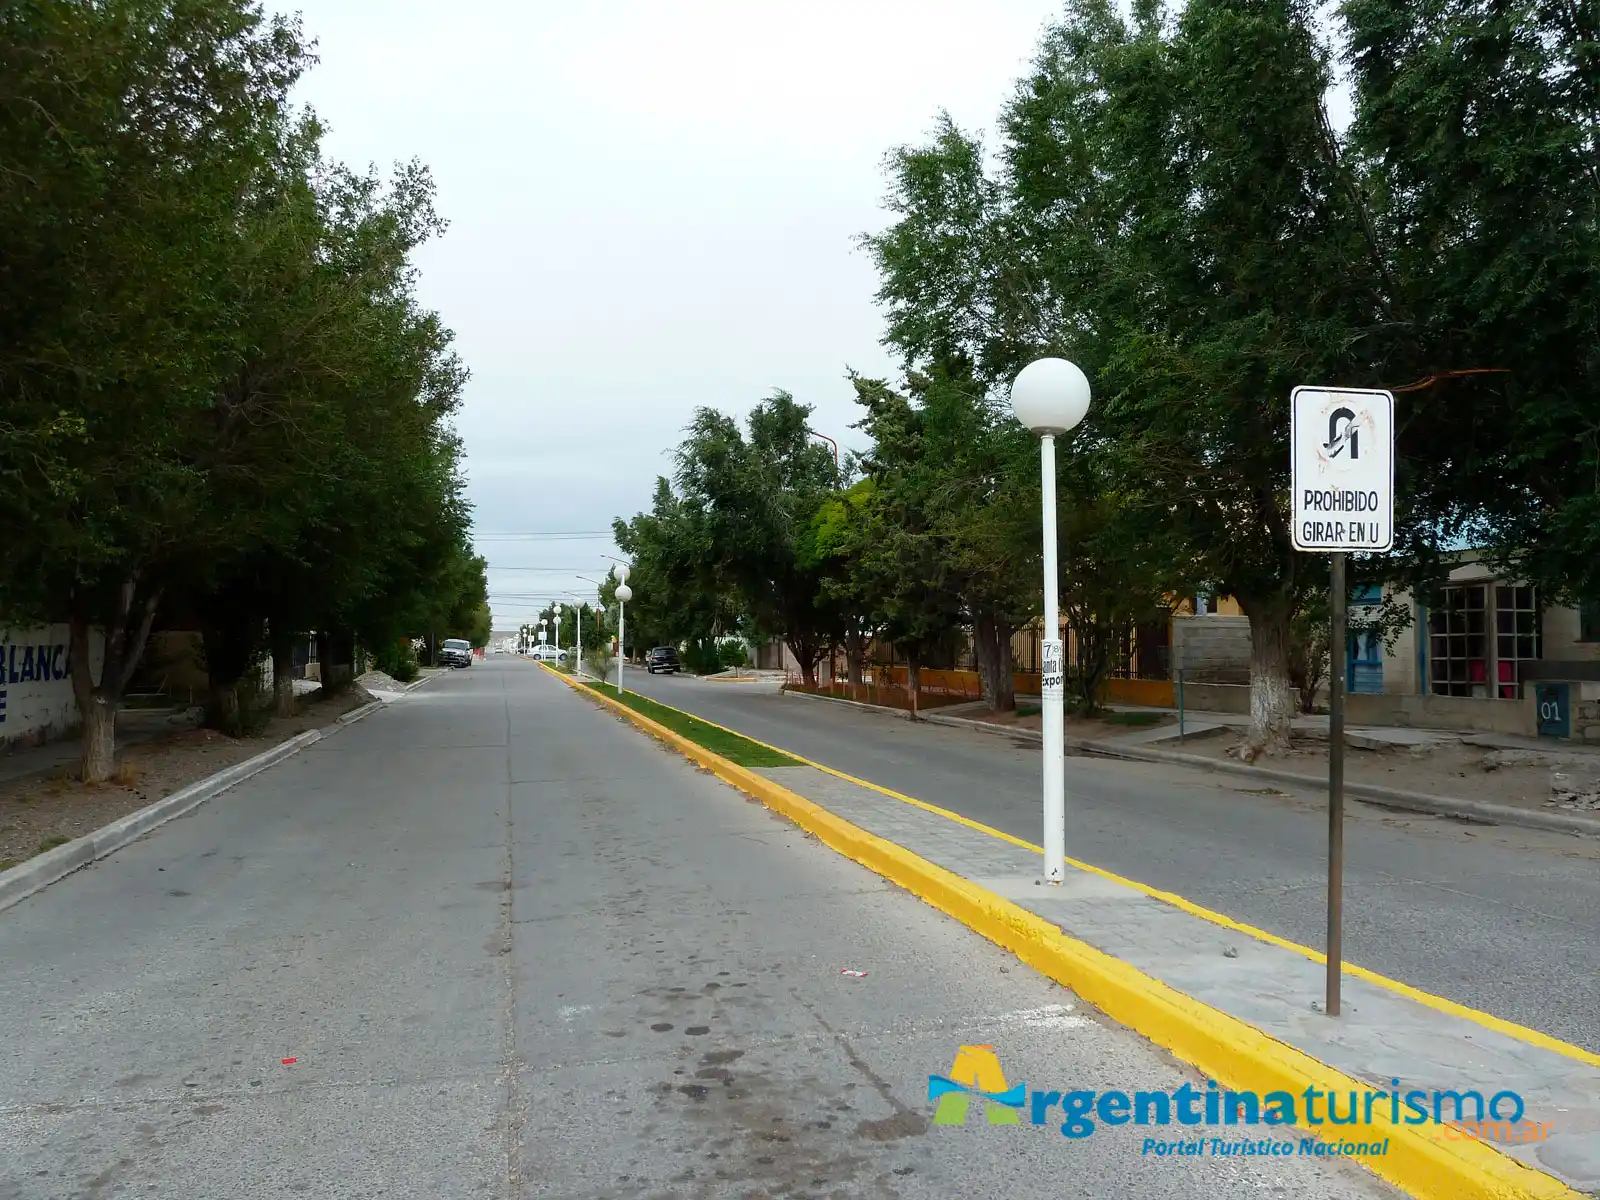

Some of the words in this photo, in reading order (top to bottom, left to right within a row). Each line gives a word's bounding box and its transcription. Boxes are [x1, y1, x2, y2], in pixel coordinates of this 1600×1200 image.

[1304, 489, 1378, 512] PROHIBIDO
[1303, 521, 1343, 542] GIRAR
[1349, 522, 1365, 542] EN
[1369, 522, 1378, 543] U
[1541, 702, 1561, 720] 01
